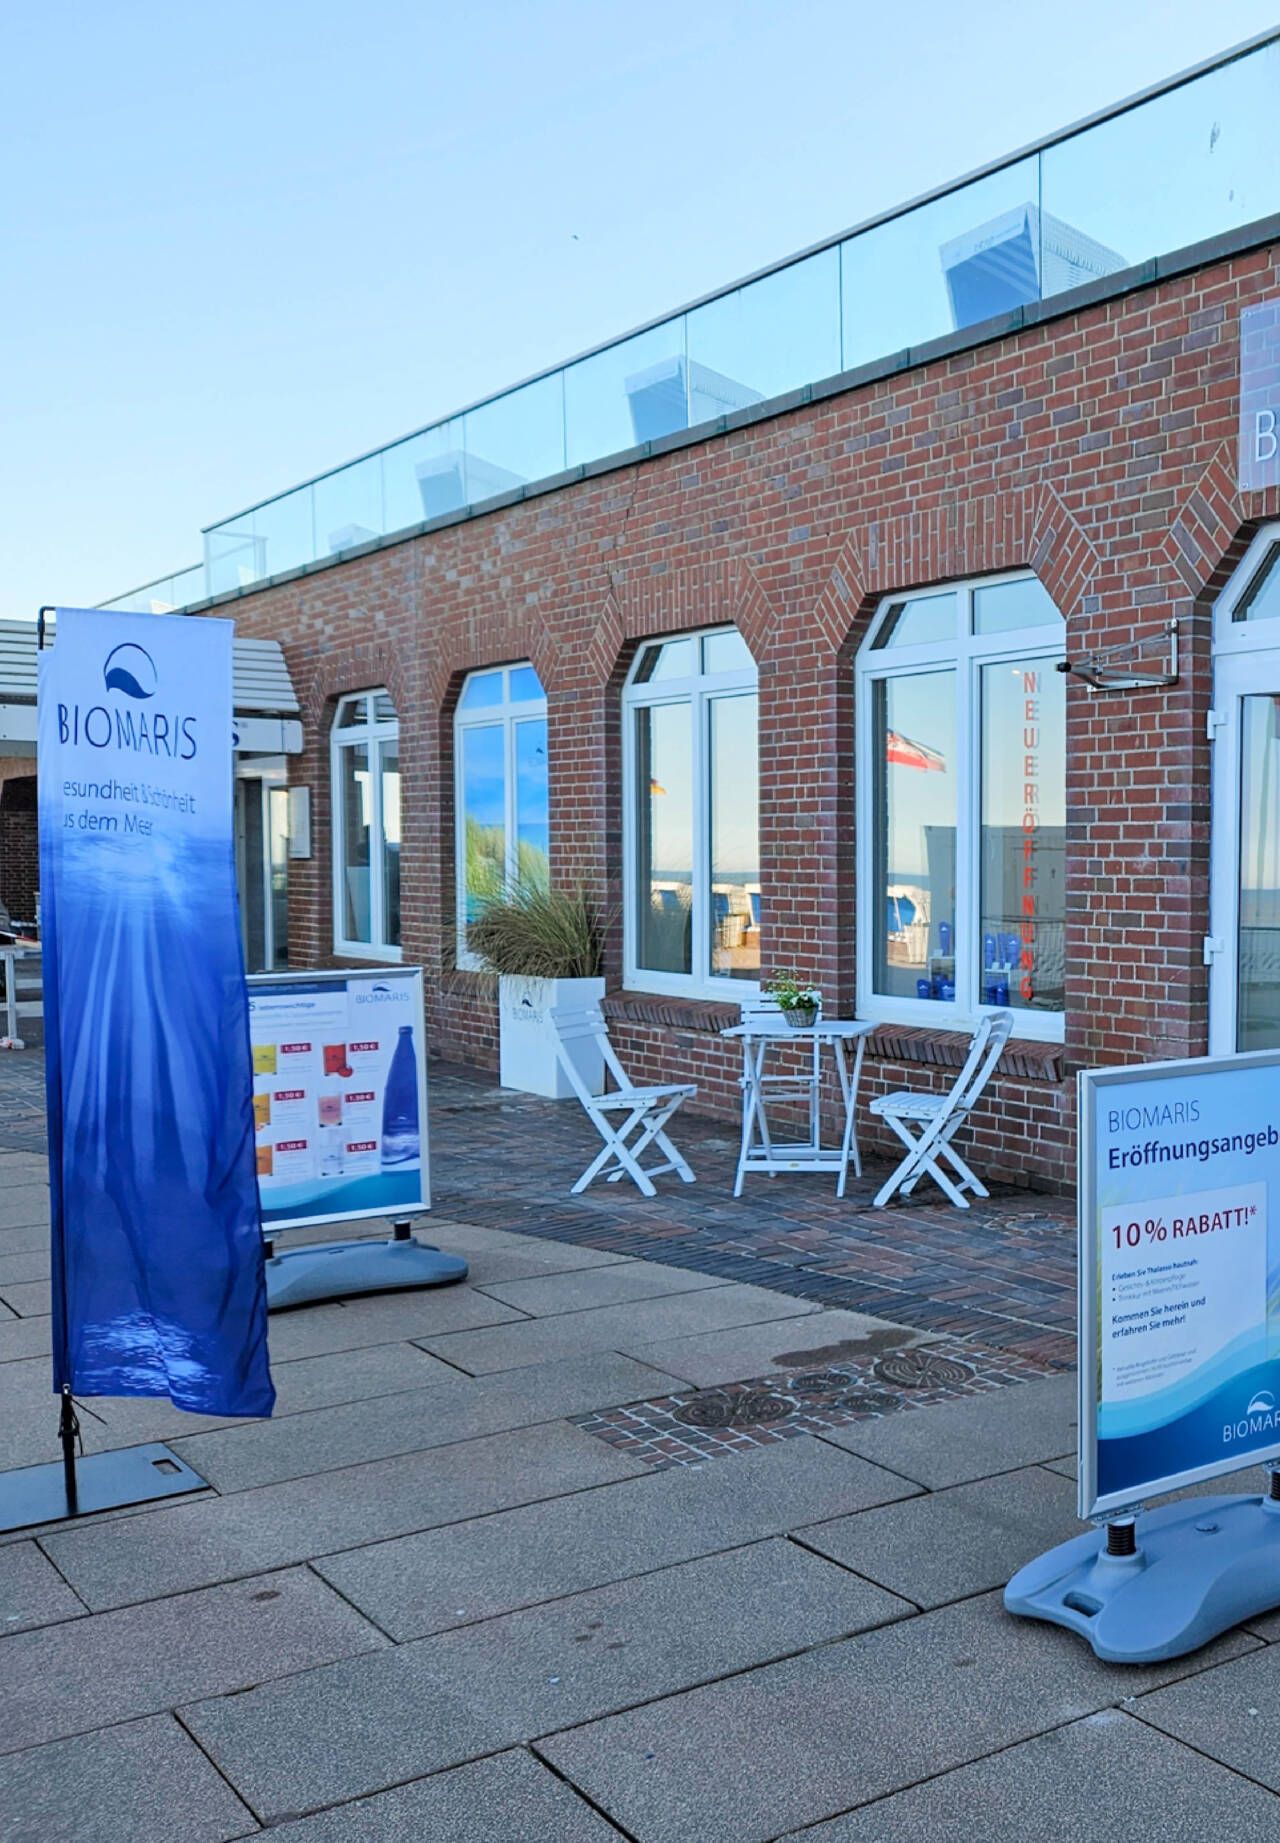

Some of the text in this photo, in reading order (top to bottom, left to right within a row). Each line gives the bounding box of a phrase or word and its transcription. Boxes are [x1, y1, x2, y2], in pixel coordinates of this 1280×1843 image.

[58, 703, 197, 760] BIOMARIS
[63, 779, 139, 803] esundheit
[78, 809, 118, 832] dem
[1019, 671, 1037, 1001] NEUERÖFFNUNG
[1108, 1100, 1200, 1133] BIOMARIS
[1112, 1295, 1207, 1326] Kommen Sie herein und
[1112, 1314, 1187, 1339] erfahren Sie mehr!
